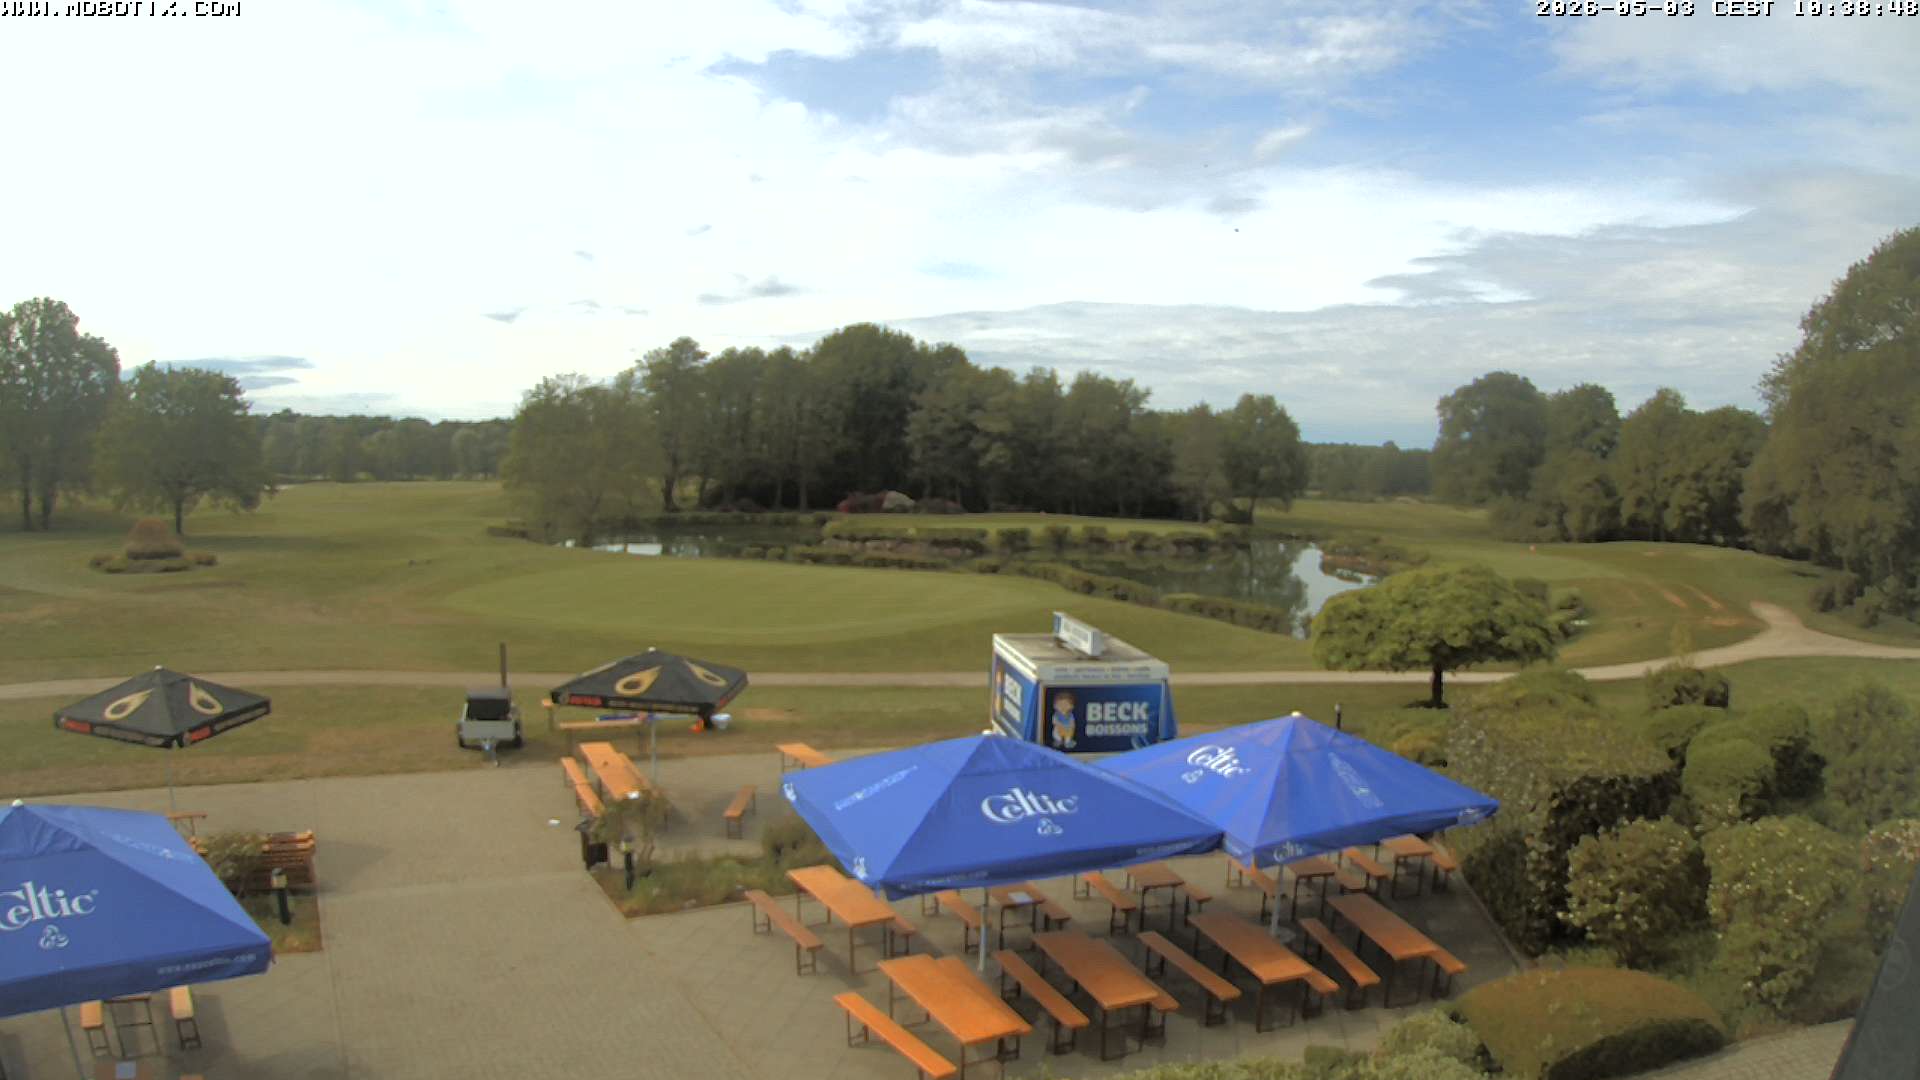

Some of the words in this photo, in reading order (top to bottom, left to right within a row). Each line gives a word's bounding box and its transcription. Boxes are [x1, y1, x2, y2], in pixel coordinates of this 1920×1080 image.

[1087, 701, 1149, 721] BECK
[1085, 723, 1148, 737] BOISSONS
[1187, 744, 1243, 779] Celtic
[981, 787, 1078, 821] Celtic
